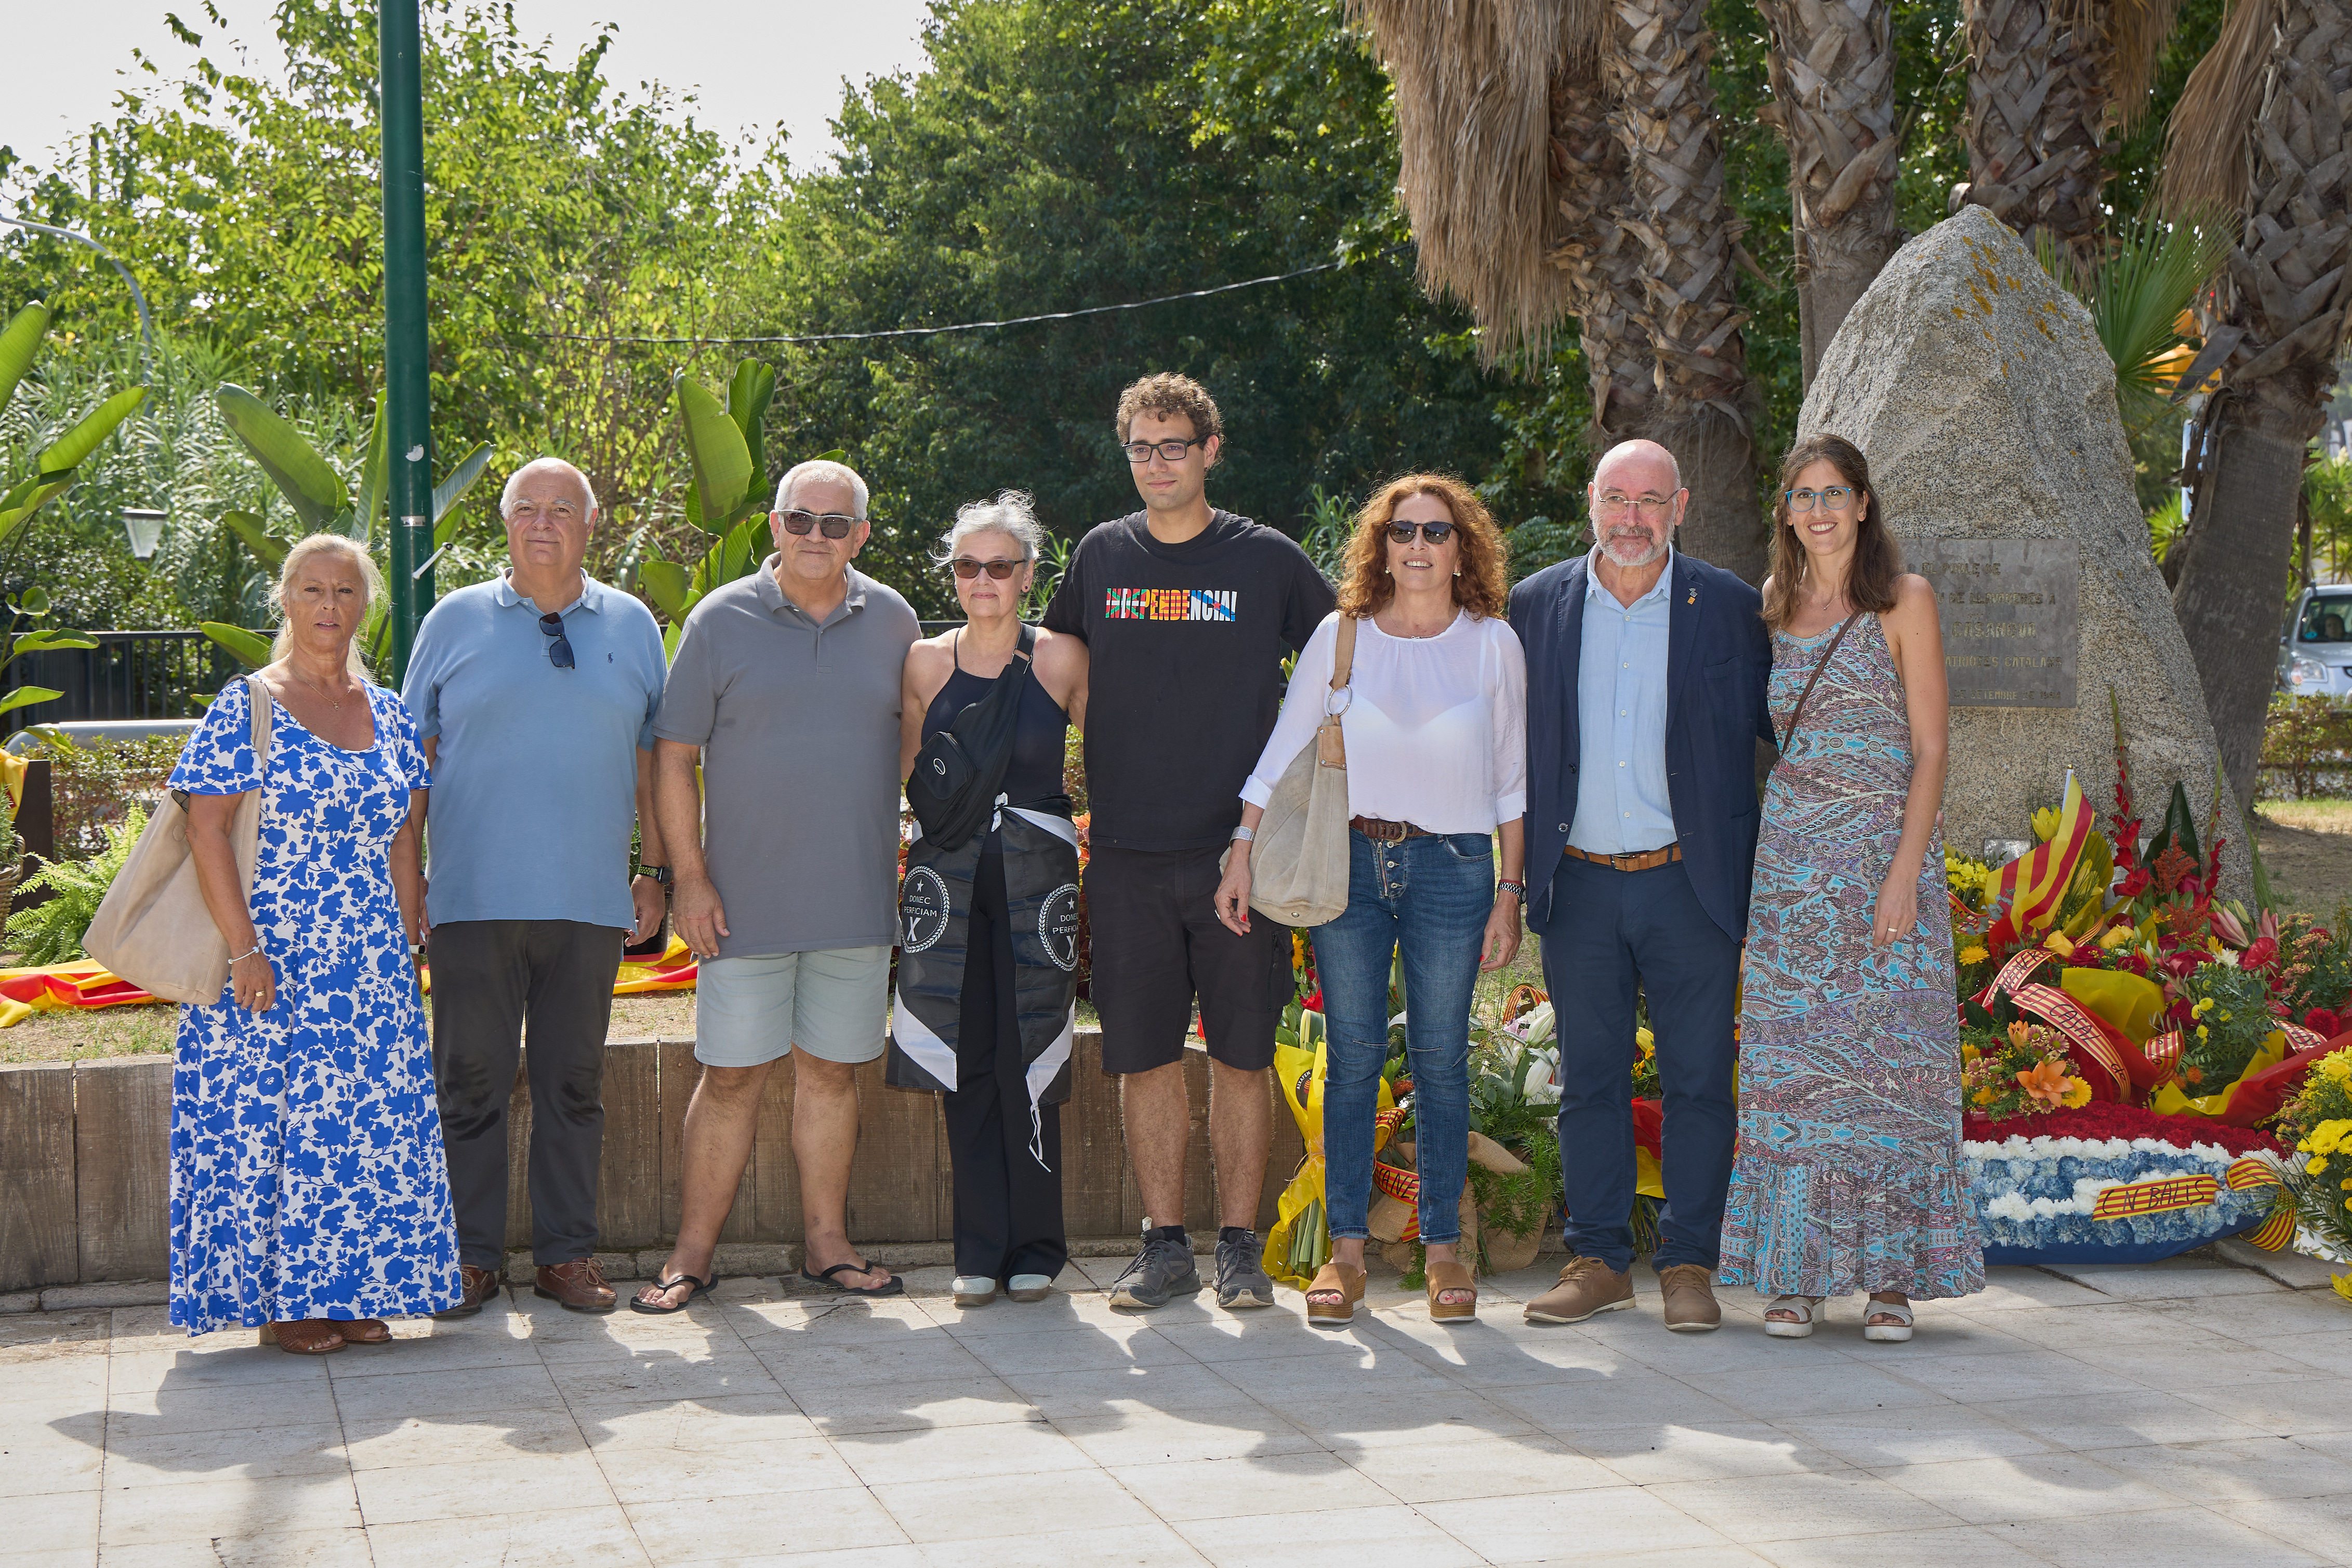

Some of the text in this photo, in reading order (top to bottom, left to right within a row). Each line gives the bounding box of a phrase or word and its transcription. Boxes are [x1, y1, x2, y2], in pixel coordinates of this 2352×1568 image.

[1922, 562, 1937, 575] EL
[1985, 563, 2001, 575] DE
[1105, 588, 1237, 622] INDEPENDENCIA!
[1949, 592, 1965, 604] DE
[2049, 593, 2056, 605] A
[1952, 621, 2037, 639] CASANOVA
[1945, 656, 2063, 668] ATRIOTES CATALANS
[1971, 689, 2018, 700] SETEMBRE
[909, 895, 931, 905] DONEC
[904, 906, 937, 918] PERFICIAM
[907, 916, 922, 942] X
[1066, 934, 1077, 960] X
[2049, 1003, 2101, 1046] CASAL
[2111, 1062, 2126, 1081] de
